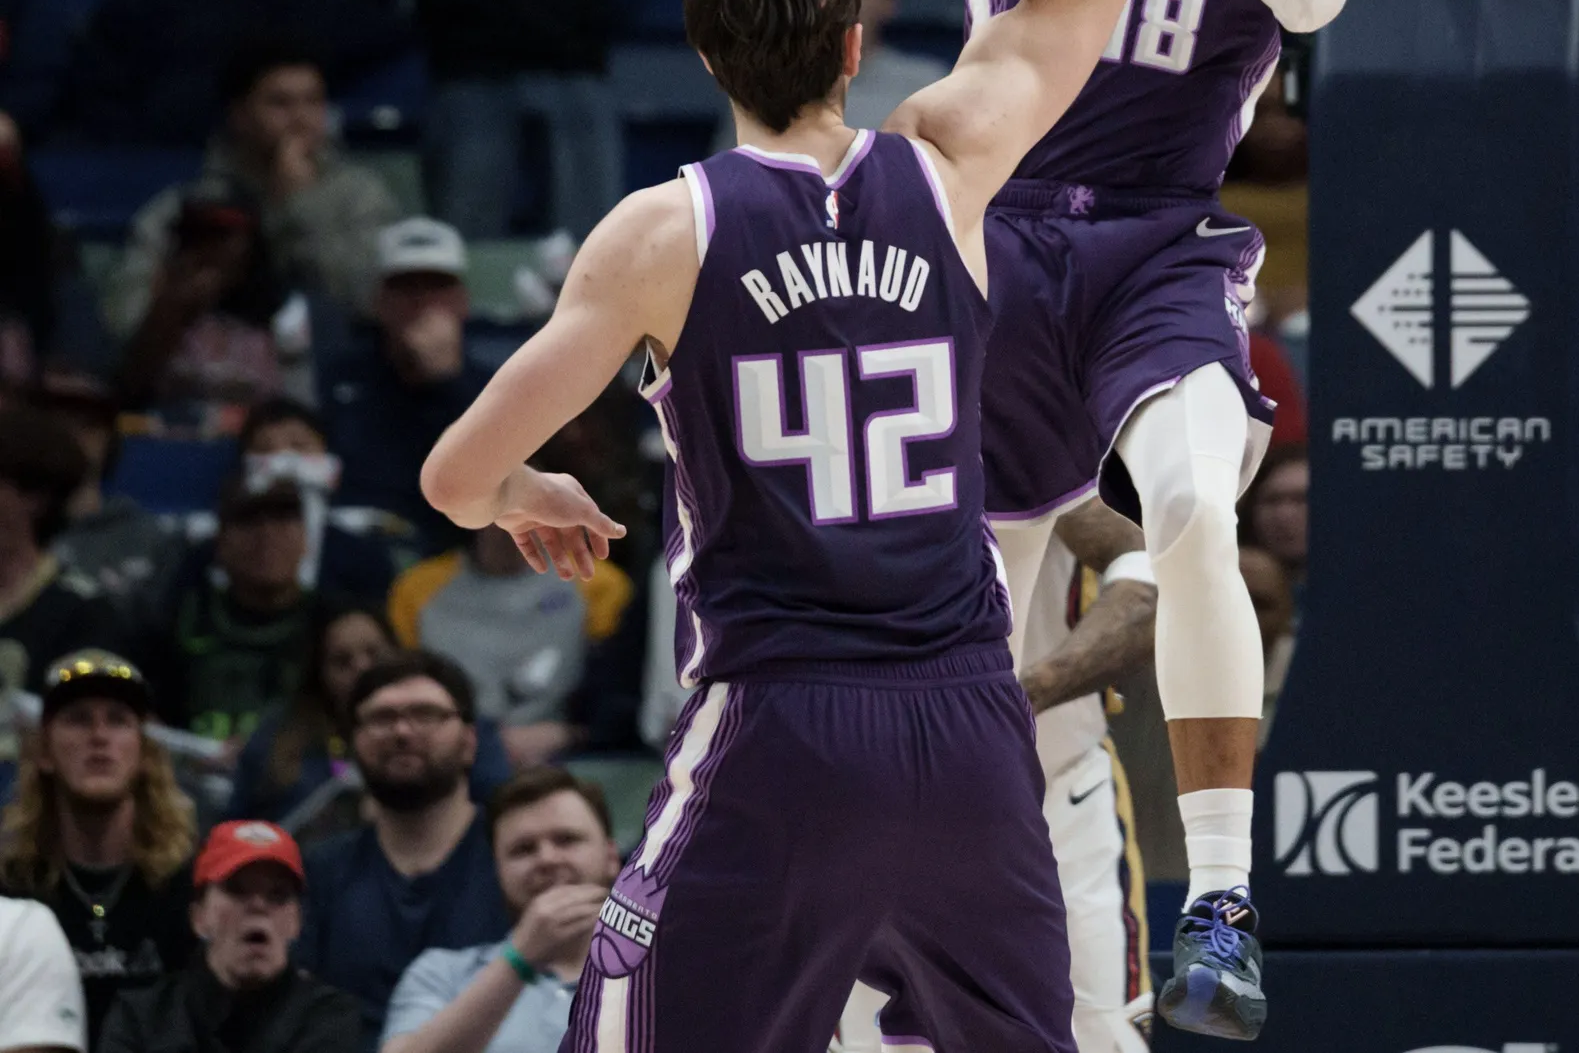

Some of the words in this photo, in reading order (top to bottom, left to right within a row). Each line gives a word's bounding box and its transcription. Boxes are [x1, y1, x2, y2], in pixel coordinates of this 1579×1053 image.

[740, 239, 930, 325] RAYNAUD
[731, 336, 959, 526] 42
[1331, 416, 1552, 443] AMERICAN
[1360, 444, 1524, 471] SAFETY
